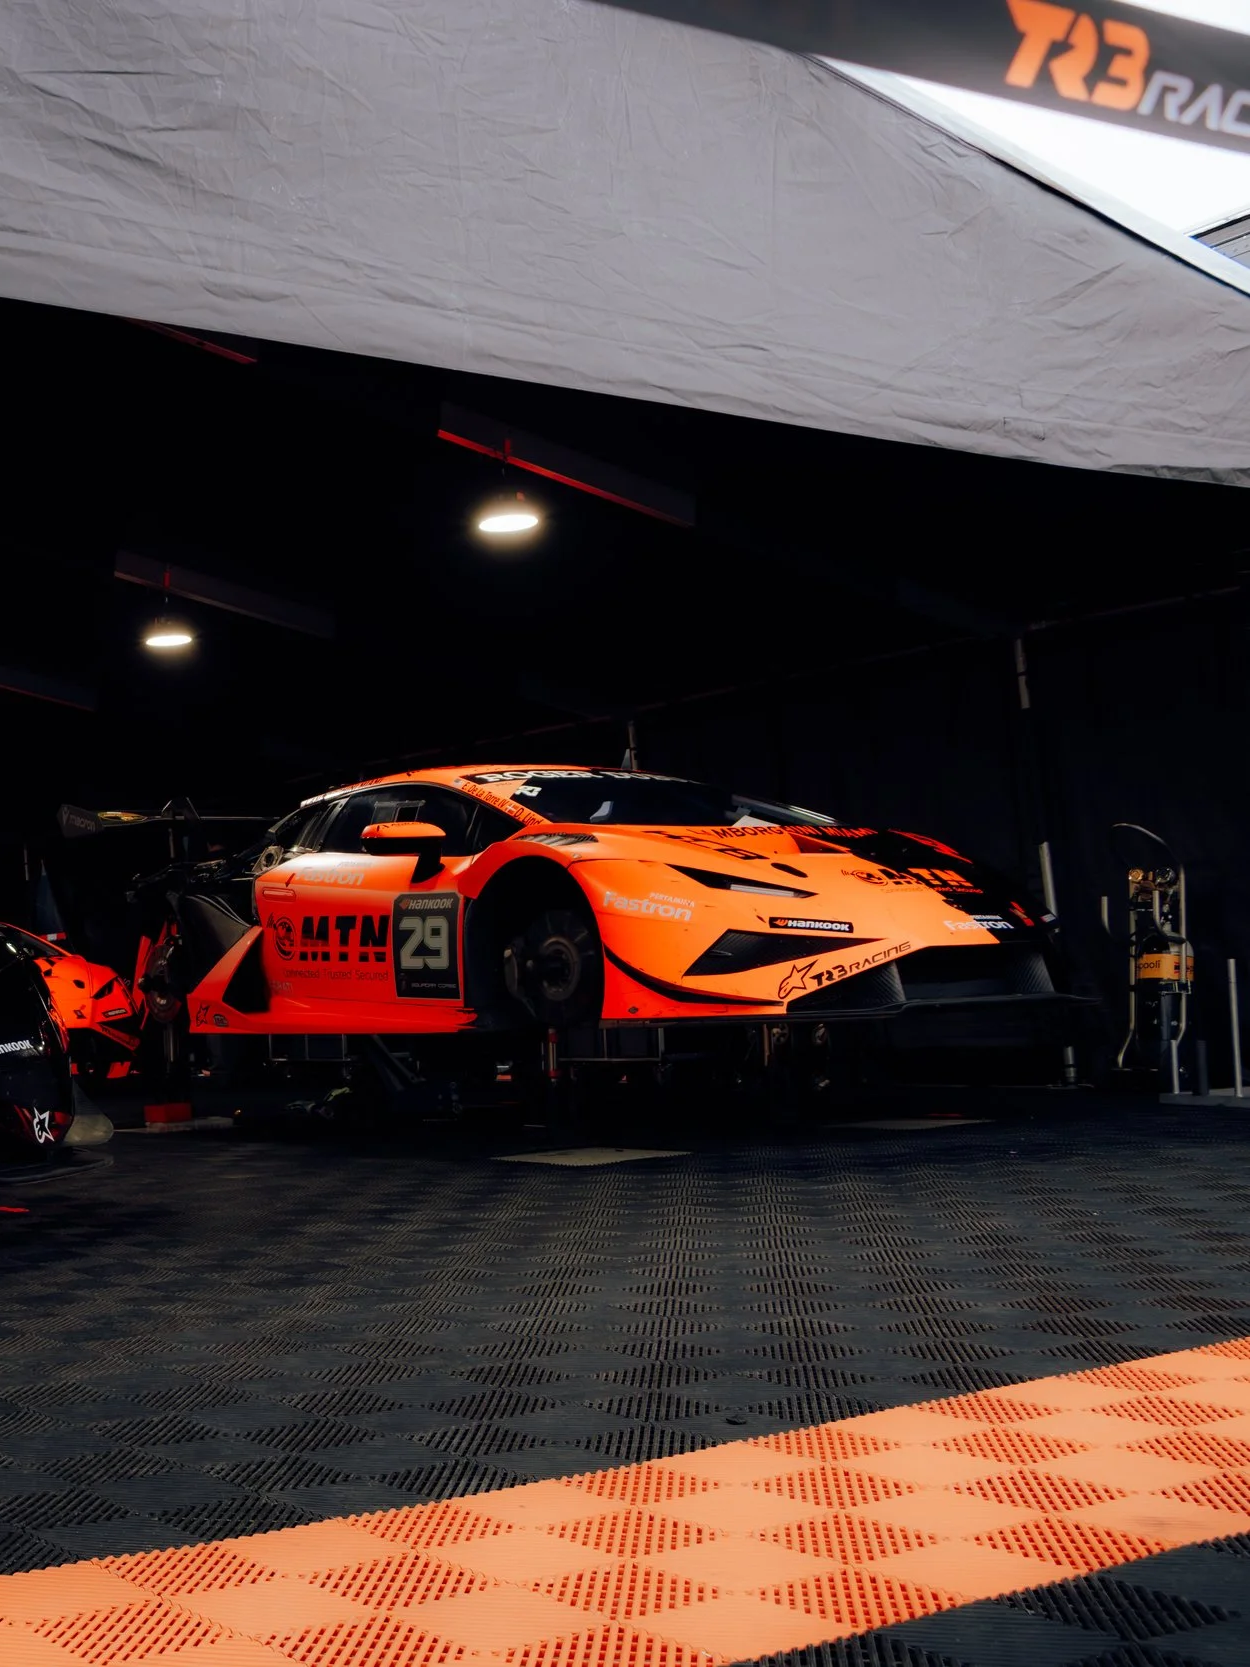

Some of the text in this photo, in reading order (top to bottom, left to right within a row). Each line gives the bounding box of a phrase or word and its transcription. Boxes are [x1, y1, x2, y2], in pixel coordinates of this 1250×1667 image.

[1004, 0, 1150, 111] TR3
[602, 891, 692, 922] Fastron
[299, 915, 391, 963] MTN
[399, 915, 450, 970] 29
[810, 941, 911, 987] TR3 RACING
